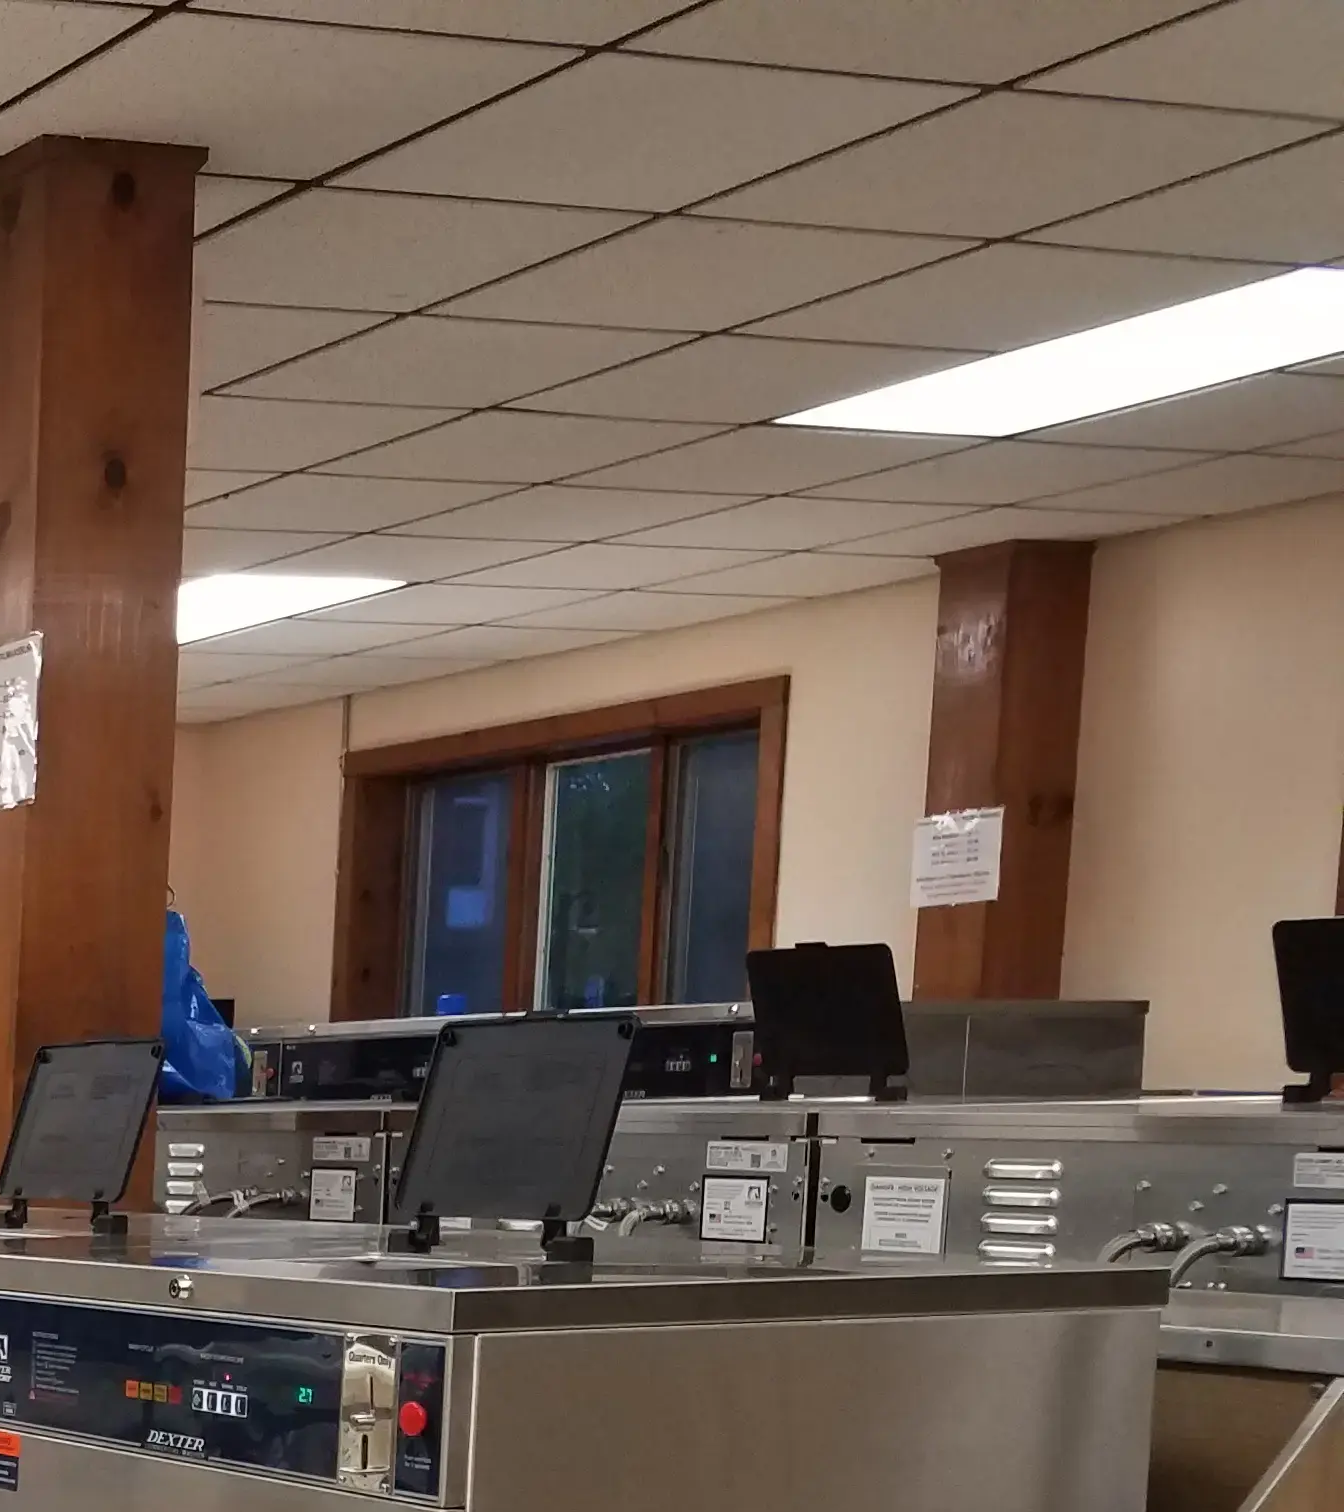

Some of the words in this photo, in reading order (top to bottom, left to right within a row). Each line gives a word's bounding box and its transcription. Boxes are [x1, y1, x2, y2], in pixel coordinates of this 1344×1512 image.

[349, 1351, 375, 1365] Quarters
[378, 1355, 392, 1369] Only
[147, 1429, 205, 1452] DEXTER
